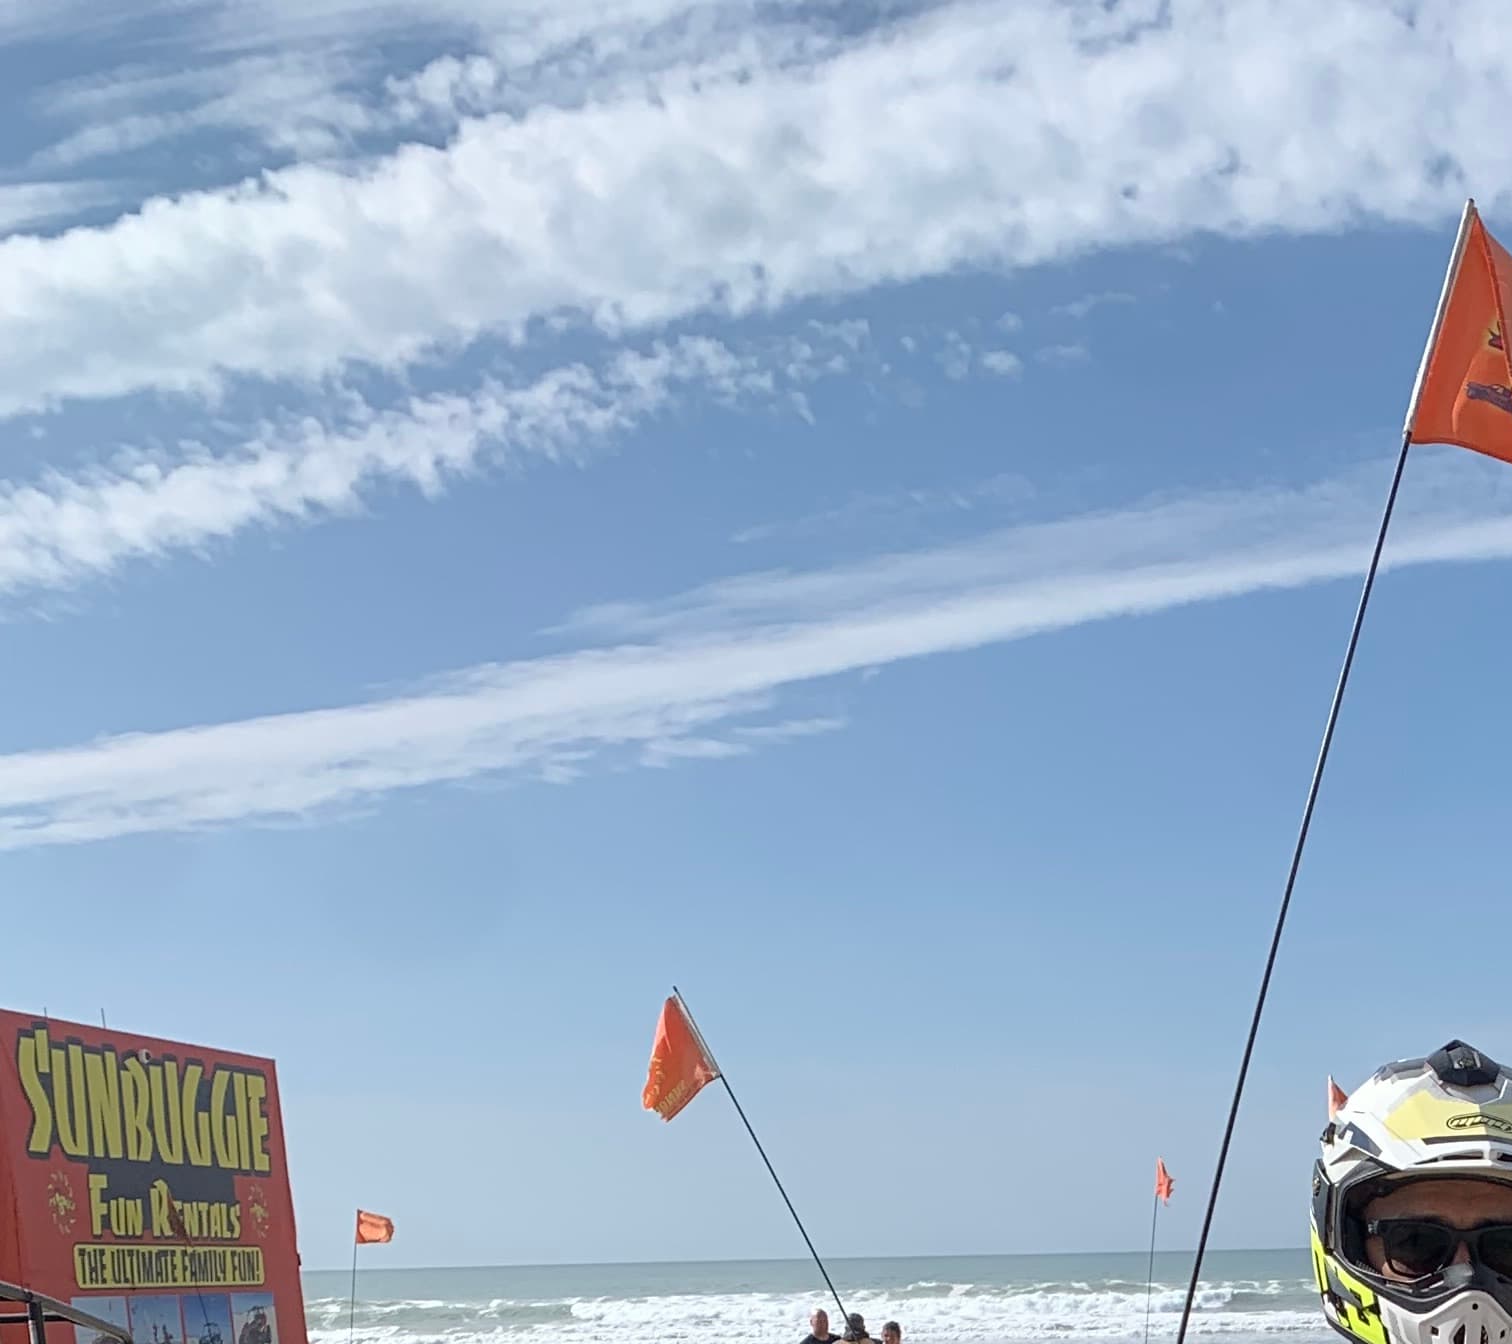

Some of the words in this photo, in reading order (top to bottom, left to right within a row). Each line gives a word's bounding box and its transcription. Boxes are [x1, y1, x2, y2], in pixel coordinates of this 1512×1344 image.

[17, 1025, 271, 1173] SUNBUGGIE
[78, 1247, 107, 1285] THE
[111, 1248, 177, 1284] ULTIMATE
[180, 1249, 227, 1283] FAMILY
[231, 1250, 261, 1283] FUN!
